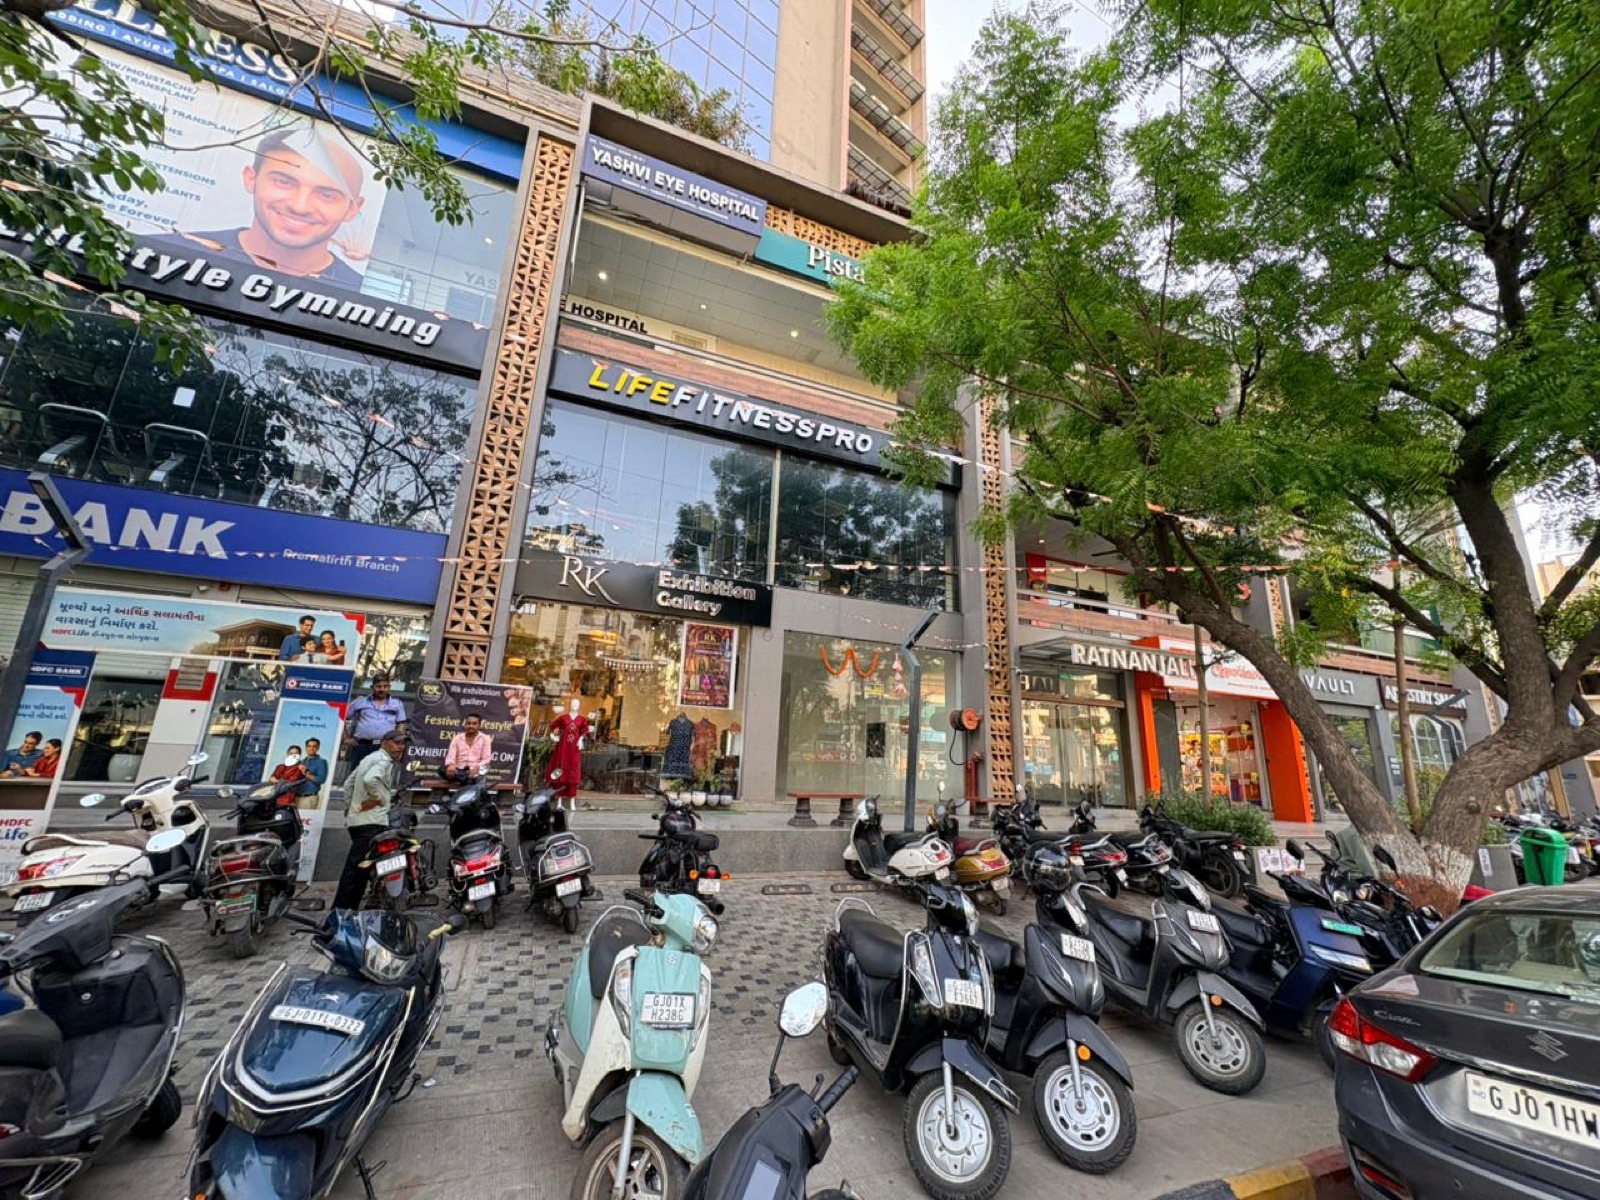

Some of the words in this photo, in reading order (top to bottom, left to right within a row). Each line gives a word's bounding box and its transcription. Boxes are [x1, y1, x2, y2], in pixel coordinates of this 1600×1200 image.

[49, 10, 106, 32] DDING
[125, 75, 196, 102] TRANSPLANT
[172, 108, 241, 136] TRANSPLANT
[165, 186, 202, 202] LANTS
[592, 146, 650, 181] YASHVI
[655, 170, 686, 194] EYE
[689, 183, 760, 222] HOSPITAL
[119, 205, 178, 226] Forever
[240, 273, 442, 346] Gymming
[571, 302, 649, 334] HOSPITAL
[0, 490, 237, 560] BANK
[355, 556, 400, 572] Branch
[559, 555, 621, 605] RK
[658, 570, 757, 600] Exhibition
[656, 592, 722, 617] Gallery
[463, 686, 501, 697] exhibition
[1304, 674, 1355, 695] VAULT
[460, 697, 488, 708] gallery
[425, 714, 460, 727] Festive
[408, 745, 450, 758] EXHIBIT
[1489, 1085, 1600, 1140] GJ01HW
